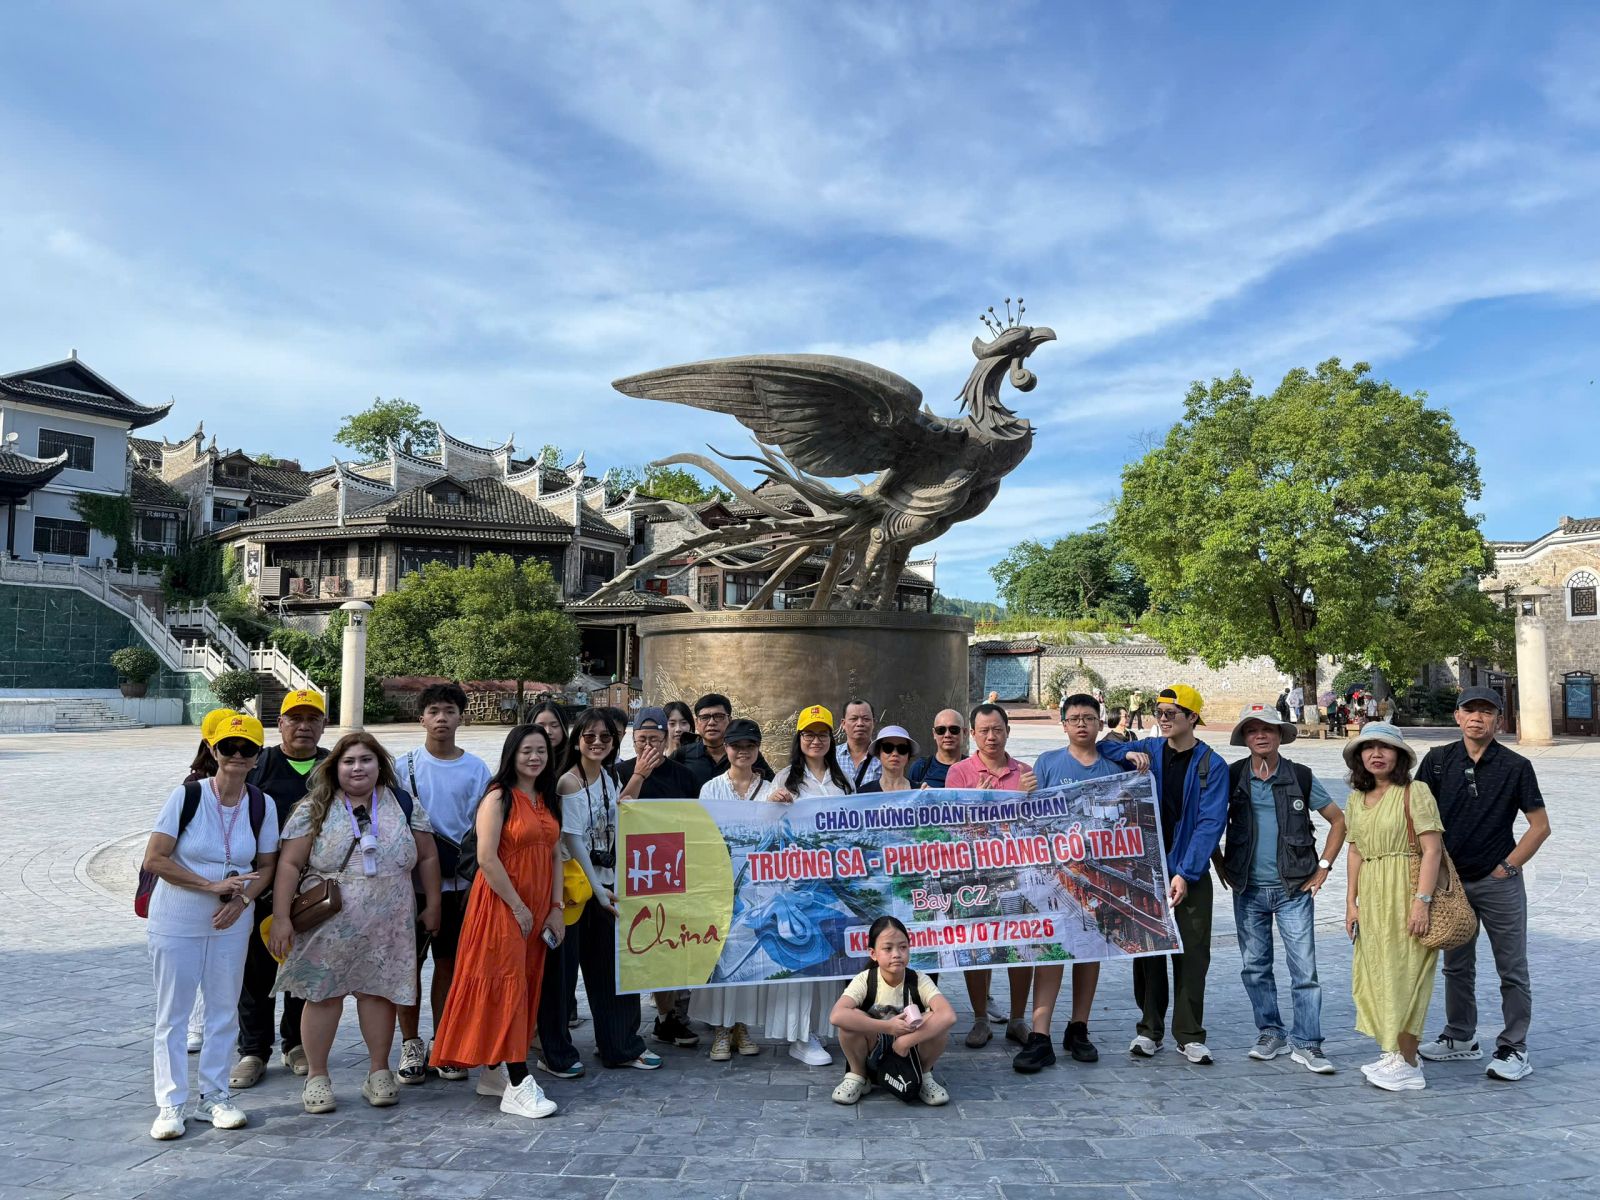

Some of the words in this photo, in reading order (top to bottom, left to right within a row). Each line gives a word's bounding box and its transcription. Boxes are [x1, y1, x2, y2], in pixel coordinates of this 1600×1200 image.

[815, 808, 860, 830] CHÀO
[864, 804, 915, 828] MỪNG
[919, 802, 964, 825] ĐOÀN
[969, 803, 1017, 822] THAM
[1021, 797, 1067, 820] QUAN
[628, 844, 684, 892] Hi!
[748, 845, 831, 881] TRƯỜNG
[837, 848, 866, 877] SA
[871, 859, 880, 867] -
[884, 842, 972, 877] PHƯỢNG
[975, 834, 1050, 868] HOÀNG
[1053, 822, 1084, 861] CỔ
[1088, 818, 1144, 858] TRẤN
[912, 888, 951, 913] Bay
[957, 885, 990, 907] CZ
[627, 902, 720, 954] China
[884, 1072, 904, 1093] PUMA
